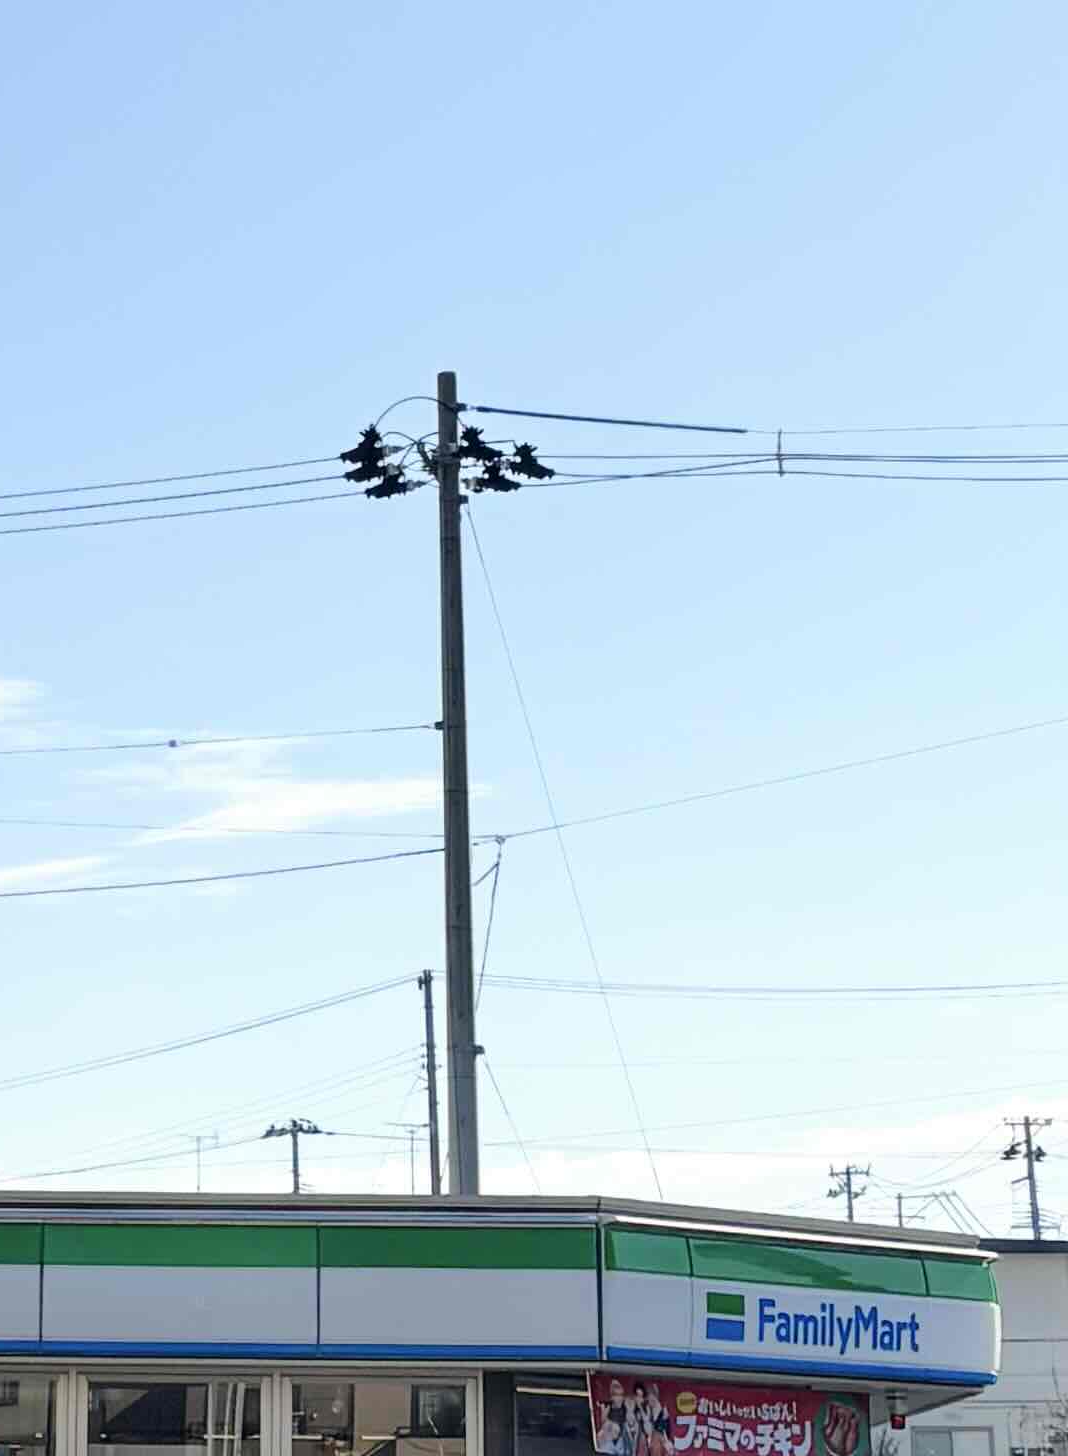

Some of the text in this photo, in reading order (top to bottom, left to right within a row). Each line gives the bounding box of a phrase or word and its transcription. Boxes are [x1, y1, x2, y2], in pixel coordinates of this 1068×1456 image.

[758, 1298, 919, 1355] FamilyMart
[674, 1415, 812, 1456] ファミマのチキン
